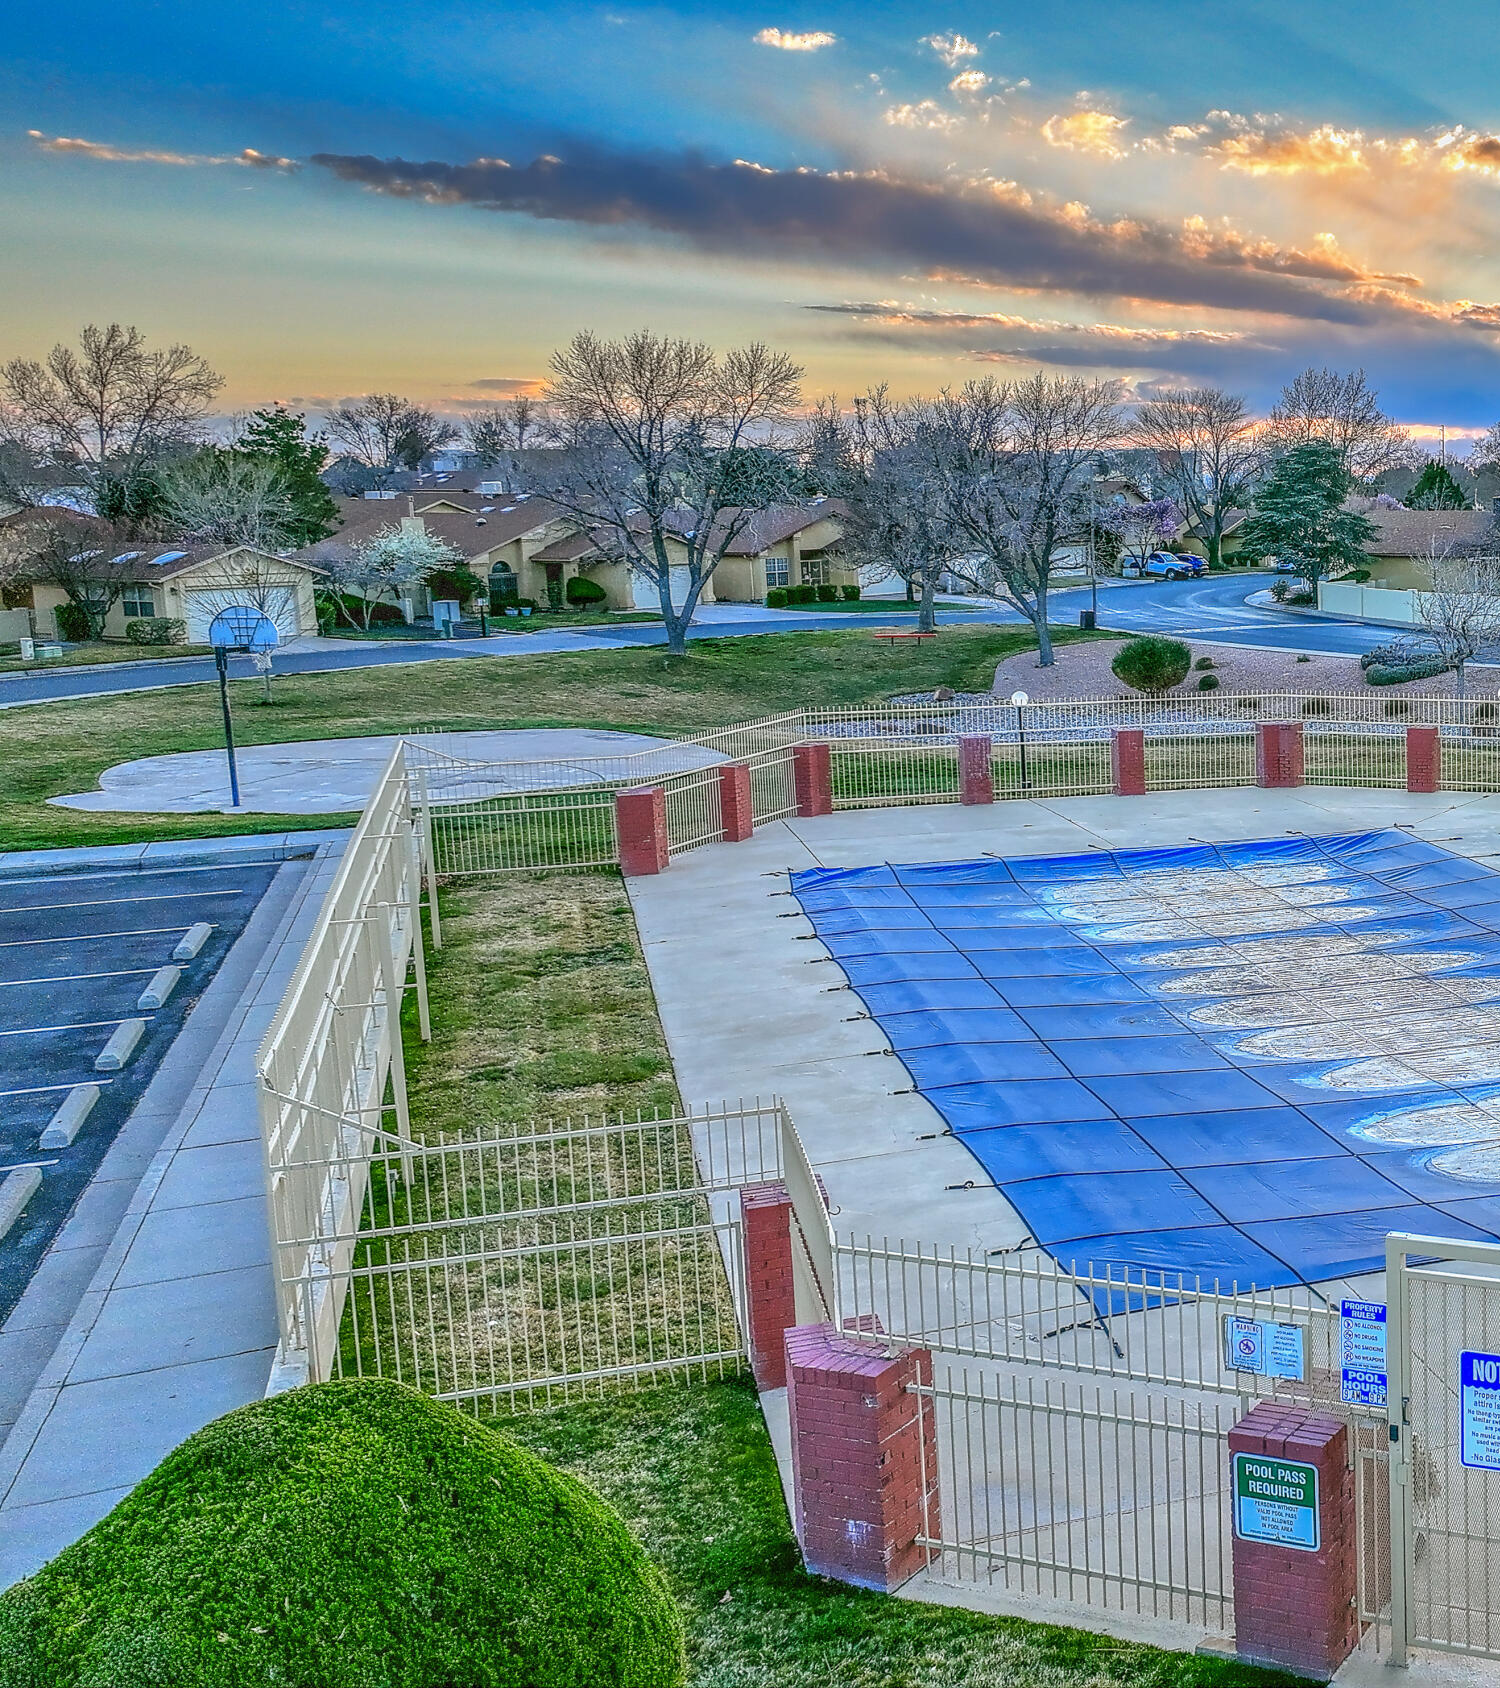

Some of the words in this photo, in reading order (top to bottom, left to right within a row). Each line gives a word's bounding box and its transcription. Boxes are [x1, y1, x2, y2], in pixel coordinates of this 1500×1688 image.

[1344, 1302, 1383, 1314] PROPERTY
[1351, 1310, 1376, 1320] RULES
[1236, 1323, 1259, 1333] WARNING
[1361, 1323, 1383, 1331] ALCOHOL
[1362, 1344, 1384, 1352] SMOKING
[1348, 1371, 1382, 1384] POOL
[1343, 1380, 1386, 1394] HOURS
[1343, 1389, 1349, 1400] 9
[1350, 1390, 1361, 1401] AM
[1375, 1393, 1387, 1404] PM
[1474, 1390, 1497, 1400] Proper
[1474, 1400, 1493, 1409] attire
[1494, 1402, 1500, 1410] is
[1472, 1416, 1491, 1424] similar
[1245, 1463, 1275, 1480] POOL
[1278, 1468, 1306, 1485] PASS
[1248, 1480, 1304, 1500] REQUIRED
[1254, 1500, 1276, 1509] PERSONS
[1276, 1504, 1299, 1512] WITHOUT
[1271, 1510, 1284, 1518] POOL
[1271, 1517, 1294, 1526] ALLOWED
[1268, 1523, 1280, 1531] POOL
